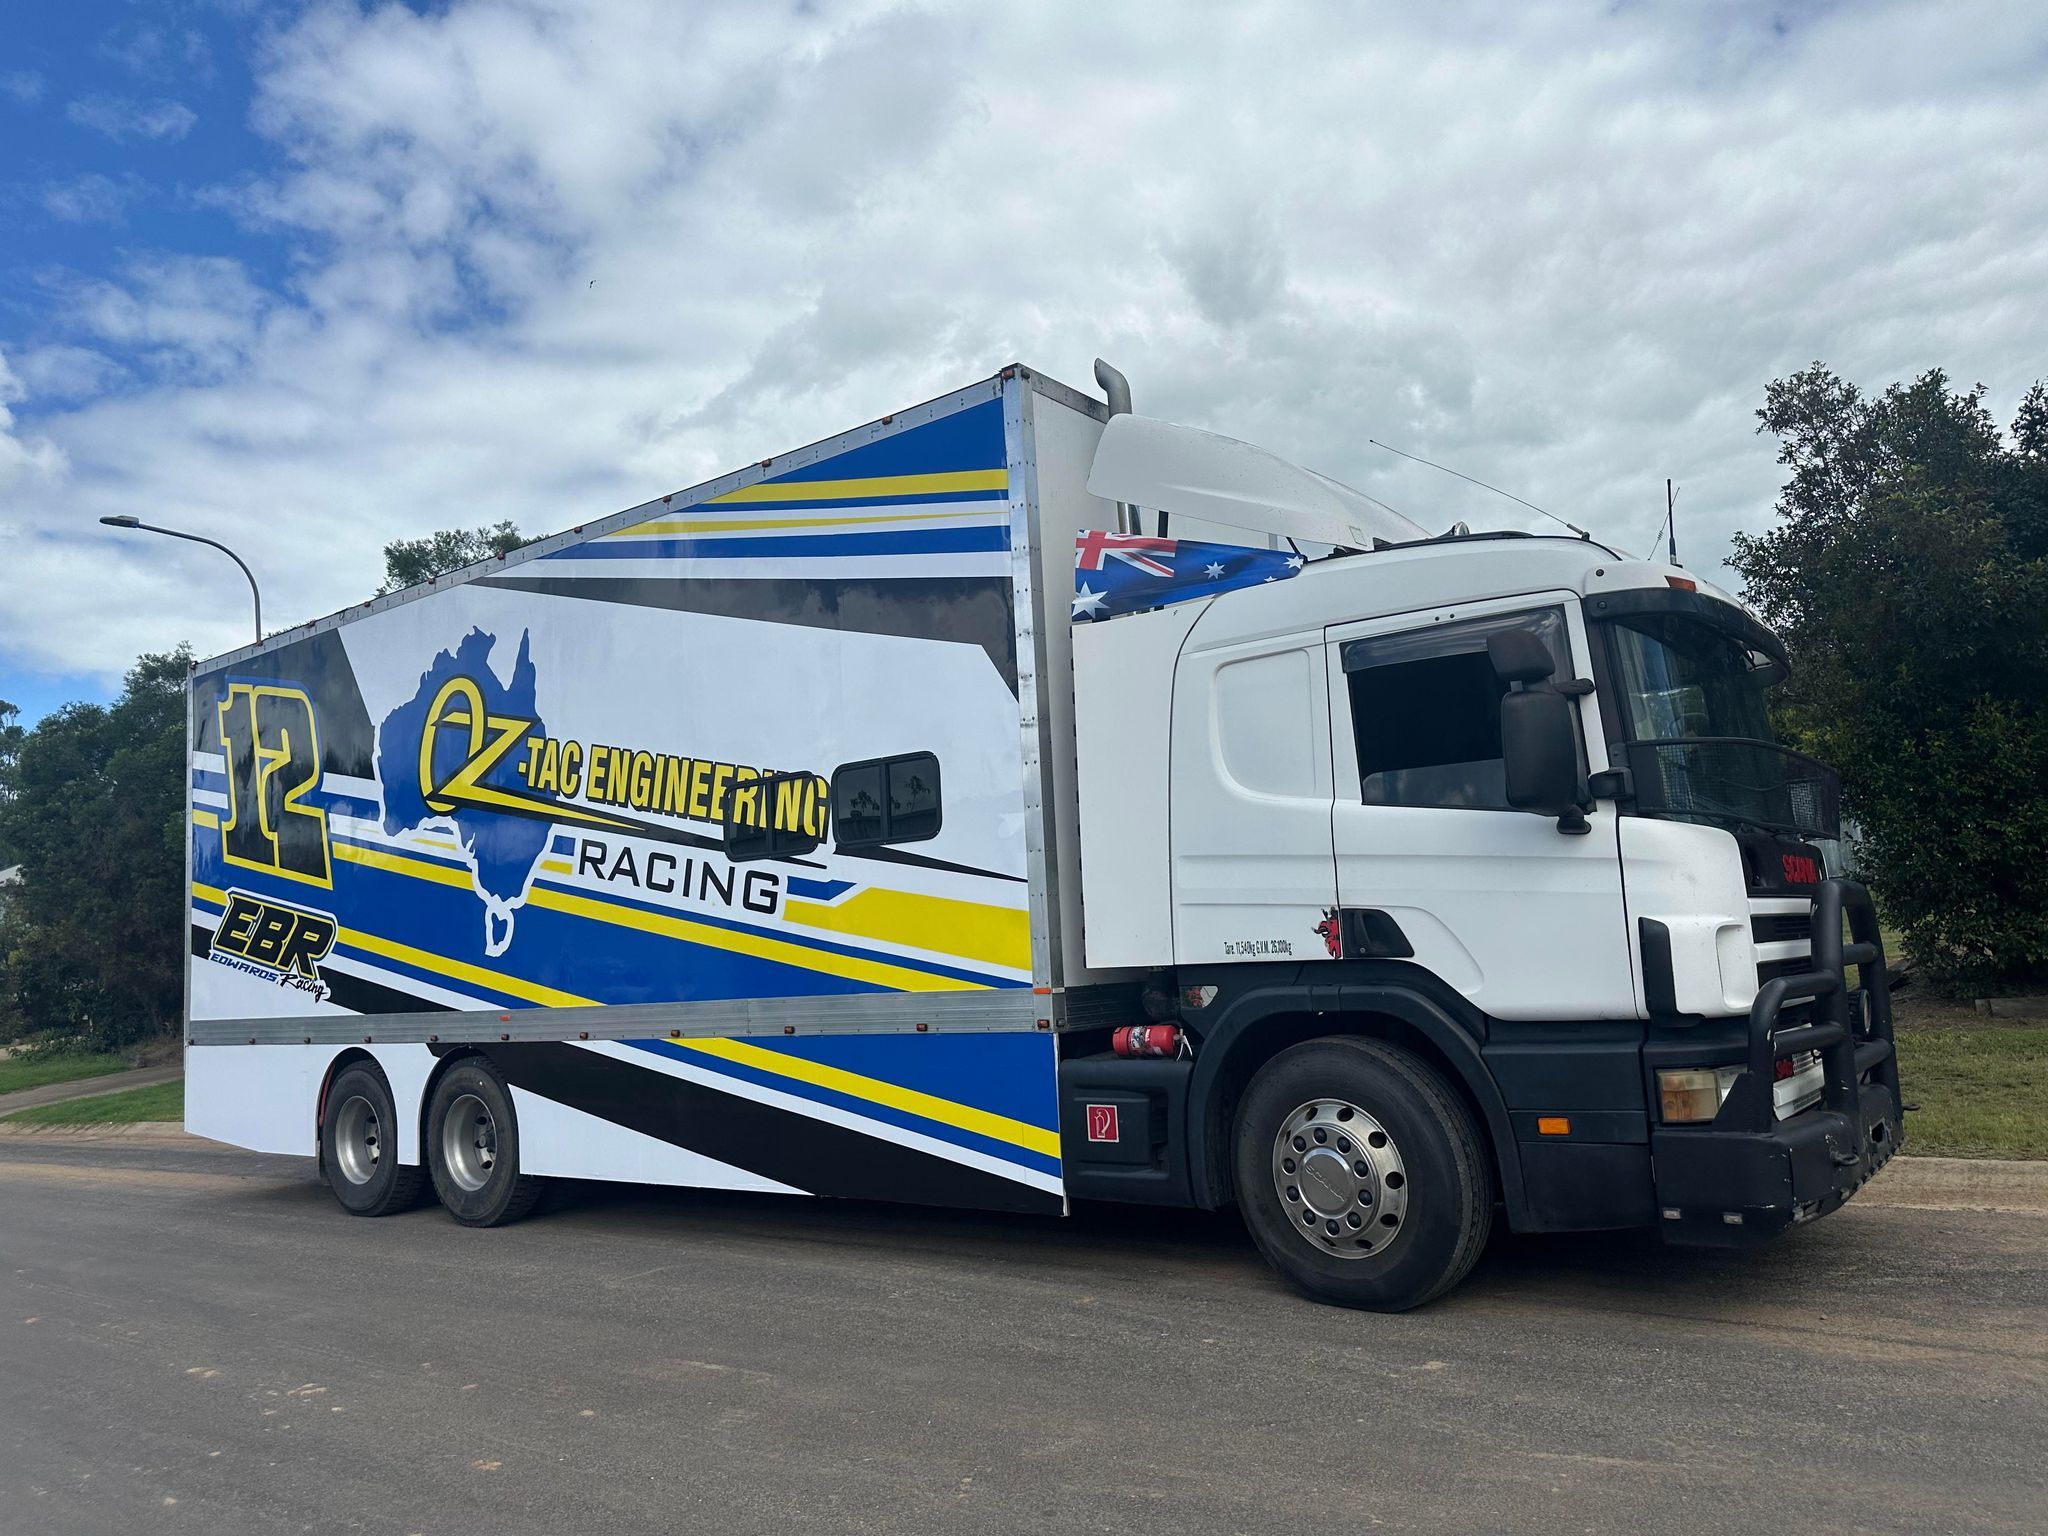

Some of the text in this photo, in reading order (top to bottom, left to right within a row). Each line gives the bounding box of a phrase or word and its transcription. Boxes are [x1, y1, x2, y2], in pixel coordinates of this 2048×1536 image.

[218, 684, 334, 890] 12
[586, 744, 831, 845] ENGINEERING
[580, 840, 780, 915] RACING
[1782, 854, 1818, 884] SCANIA
[213, 893, 337, 980] EBR
[210, 953, 329, 1004] EDWARDS Racing
